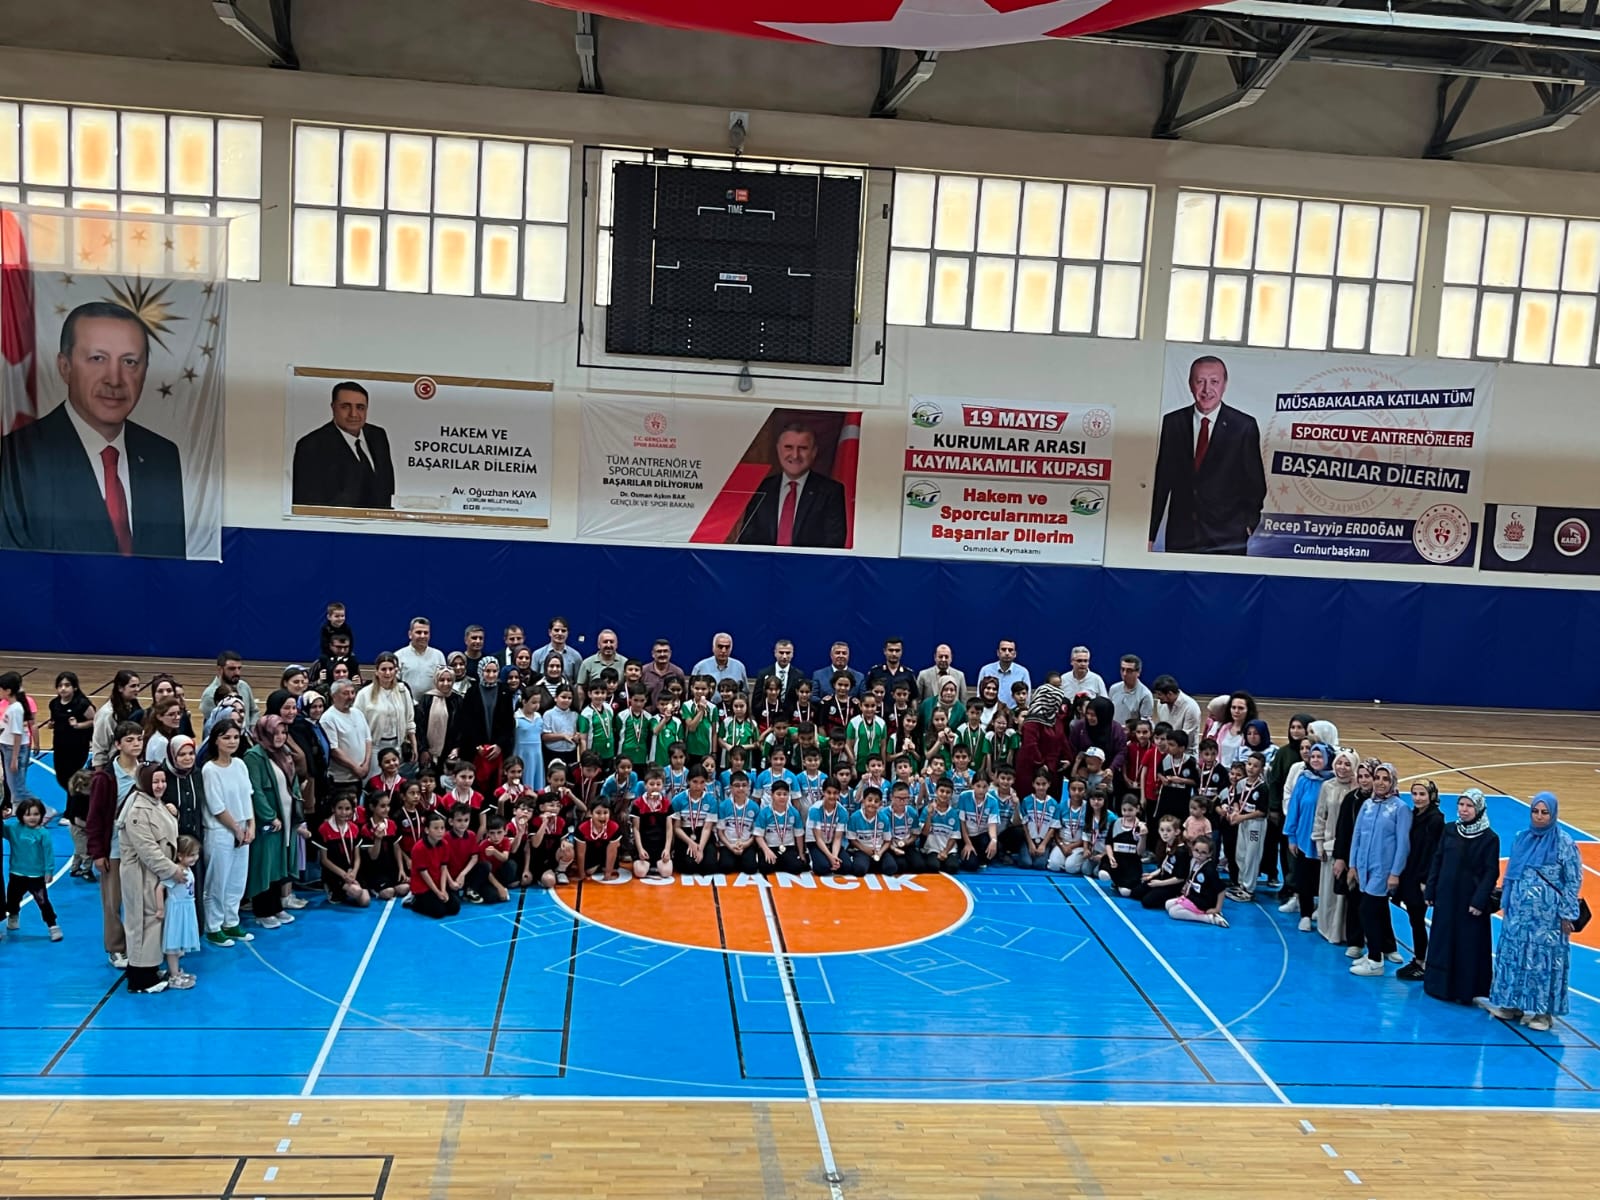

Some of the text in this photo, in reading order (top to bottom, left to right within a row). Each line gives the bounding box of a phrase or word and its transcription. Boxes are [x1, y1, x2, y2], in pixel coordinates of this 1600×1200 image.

[728, 204, 743, 214] TIME
[1278, 389, 1473, 410] MÜSABAKALARA KATILAN TÜM
[970, 410, 1058, 429] 19 MAYIS
[440, 425, 508, 440] HAKEM VE
[1295, 426, 1472, 446] SPORCU VE ANTRENÖRLERE
[414, 440, 532, 458] SPORCULARIMIZA
[933, 433, 1086, 455] KURUMLAR ARASI
[408, 456, 537, 474] BAŞARILAR DİLERİM
[607, 454, 702, 469] TÜM ANTRENÖR VE
[912, 454, 1104, 477] KAYMAKAMLIK KUPASI
[608, 466, 698, 479] SPORCULARIMIZA
[1281, 455, 1464, 490] BAŞARILAR DİLERİM.
[603, 477, 704, 489] BAŞARILAR DİLİYORUM
[452, 487, 537, 498] Av. Oğuzhan KAYA
[963, 488, 1047, 505] Hakem ve
[610, 498, 639, 507] GENÇLİK
[940, 505, 1068, 524] Sporcularımıza
[931, 524, 1074, 544] Başarılar Dilerim
[1264, 518, 1404, 537] Recep Tayyip ERDOĞAN
[963, 545, 1041, 555] Osmancık Kaymakamı
[1294, 543, 1370, 557] Cumhurbaşkanı
